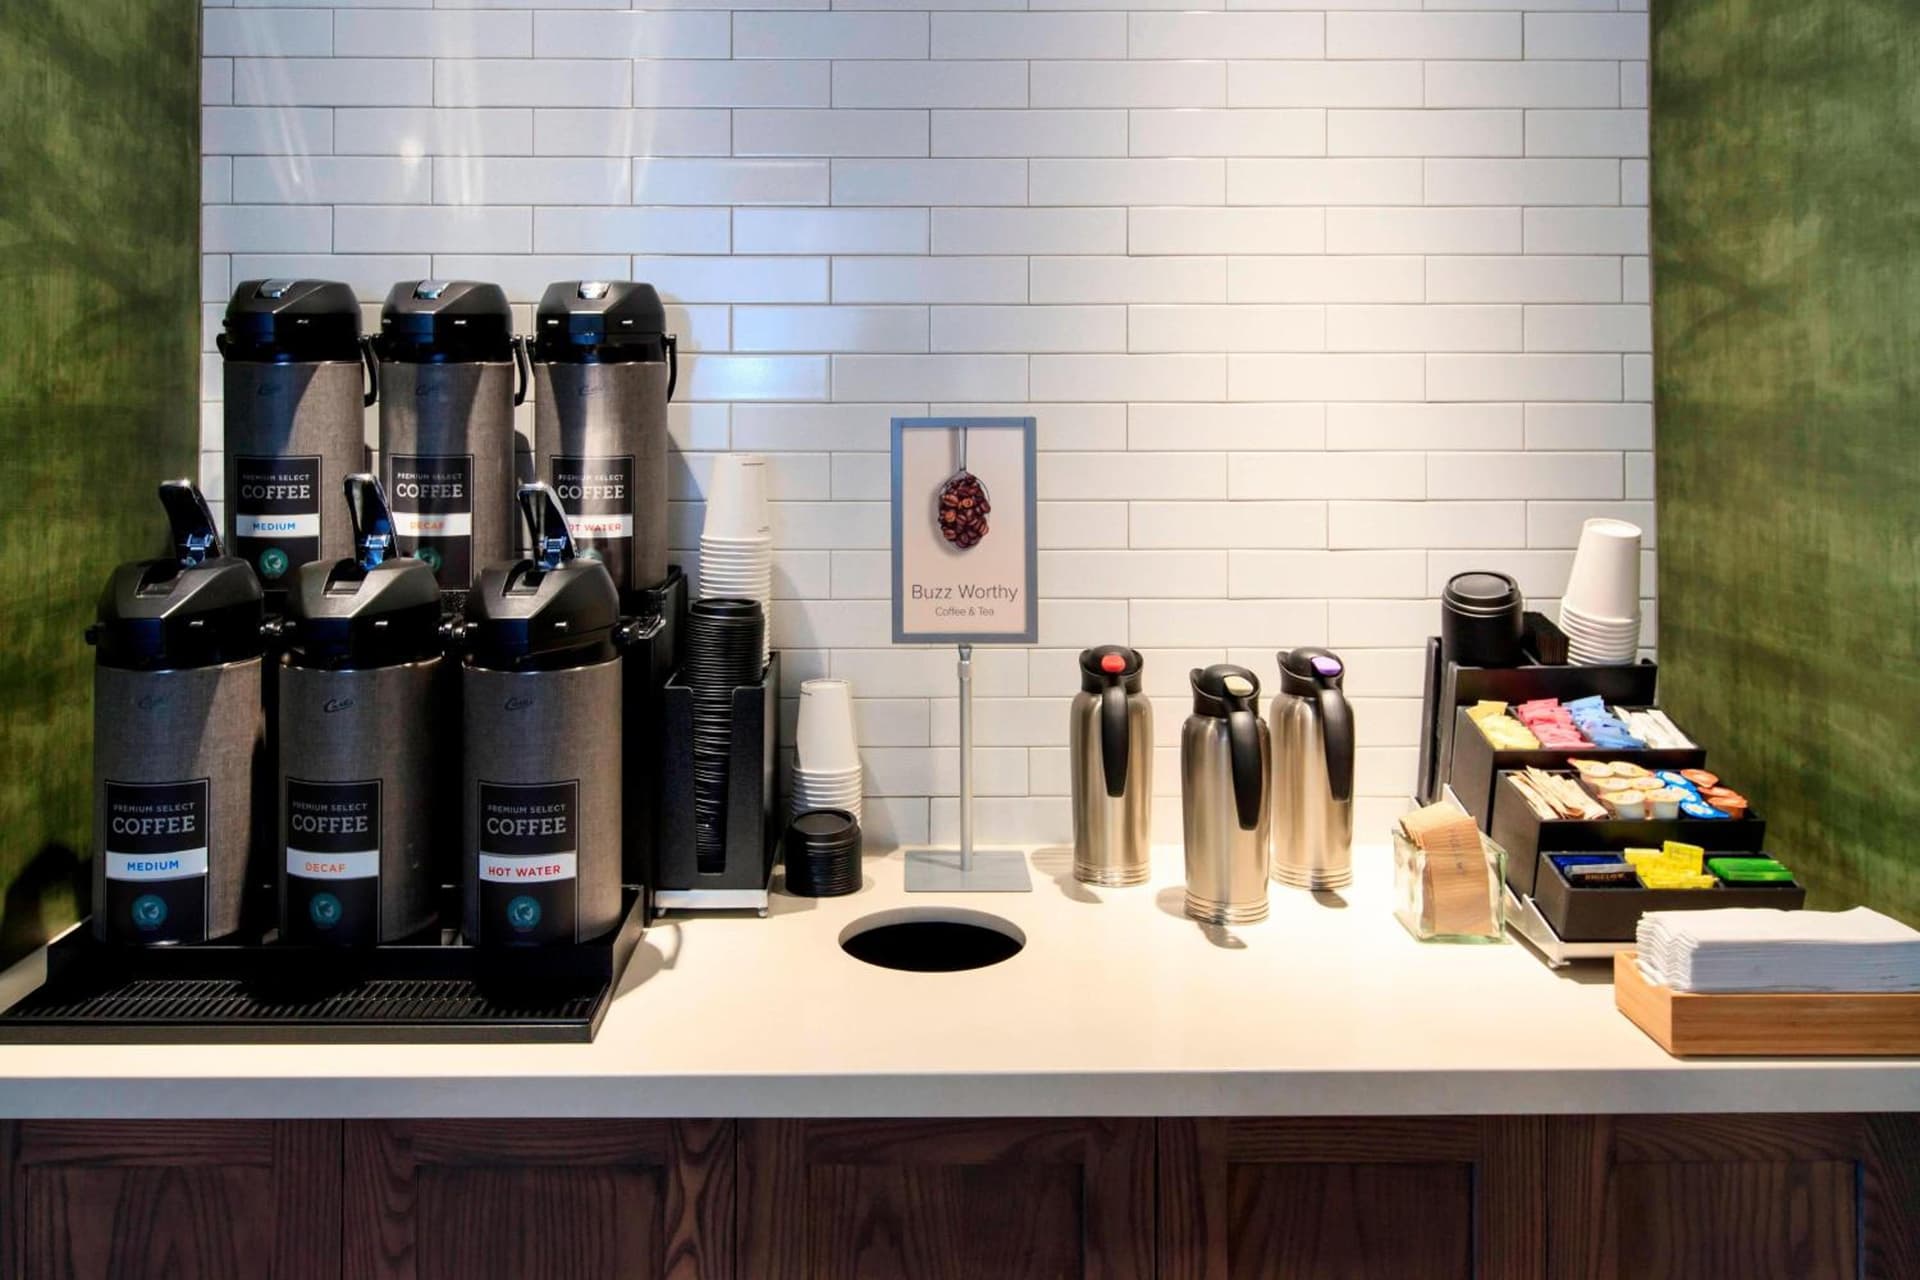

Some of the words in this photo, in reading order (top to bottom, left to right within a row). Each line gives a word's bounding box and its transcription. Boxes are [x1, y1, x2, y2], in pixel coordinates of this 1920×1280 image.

[397, 472, 430, 480] PREMIUM
[241, 484, 310, 499] COFFEE
[396, 483, 463, 498] COFFEE
[557, 484, 625, 500] COFFEE
[252, 522, 296, 531] MEDIUM
[410, 521, 445, 530] DECAF
[584, 524, 622, 532] WATER
[912, 584, 952, 599] Buzz
[958, 584, 1018, 602] Worthy
[935, 606, 967, 616] Coffee
[968, 606, 976, 616] &
[979, 606, 994, 616] Tea
[113, 803, 153, 813] PREMIUM
[156, 802, 195, 813] SELECT
[292, 801, 328, 812] PREMIUM
[331, 802, 368, 812] SELECT
[487, 804, 527, 814] PREMIUM
[530, 803, 566, 814] SELECT
[112, 815, 195, 835] COFFEE
[292, 814, 368, 834] COFFEE
[487, 816, 566, 836] COFFEE
[127, 860, 179, 871] MEDIUM
[305, 862, 346, 873] DECAF
[488, 866, 511, 876] HOT
[515, 864, 561, 877] WATER
